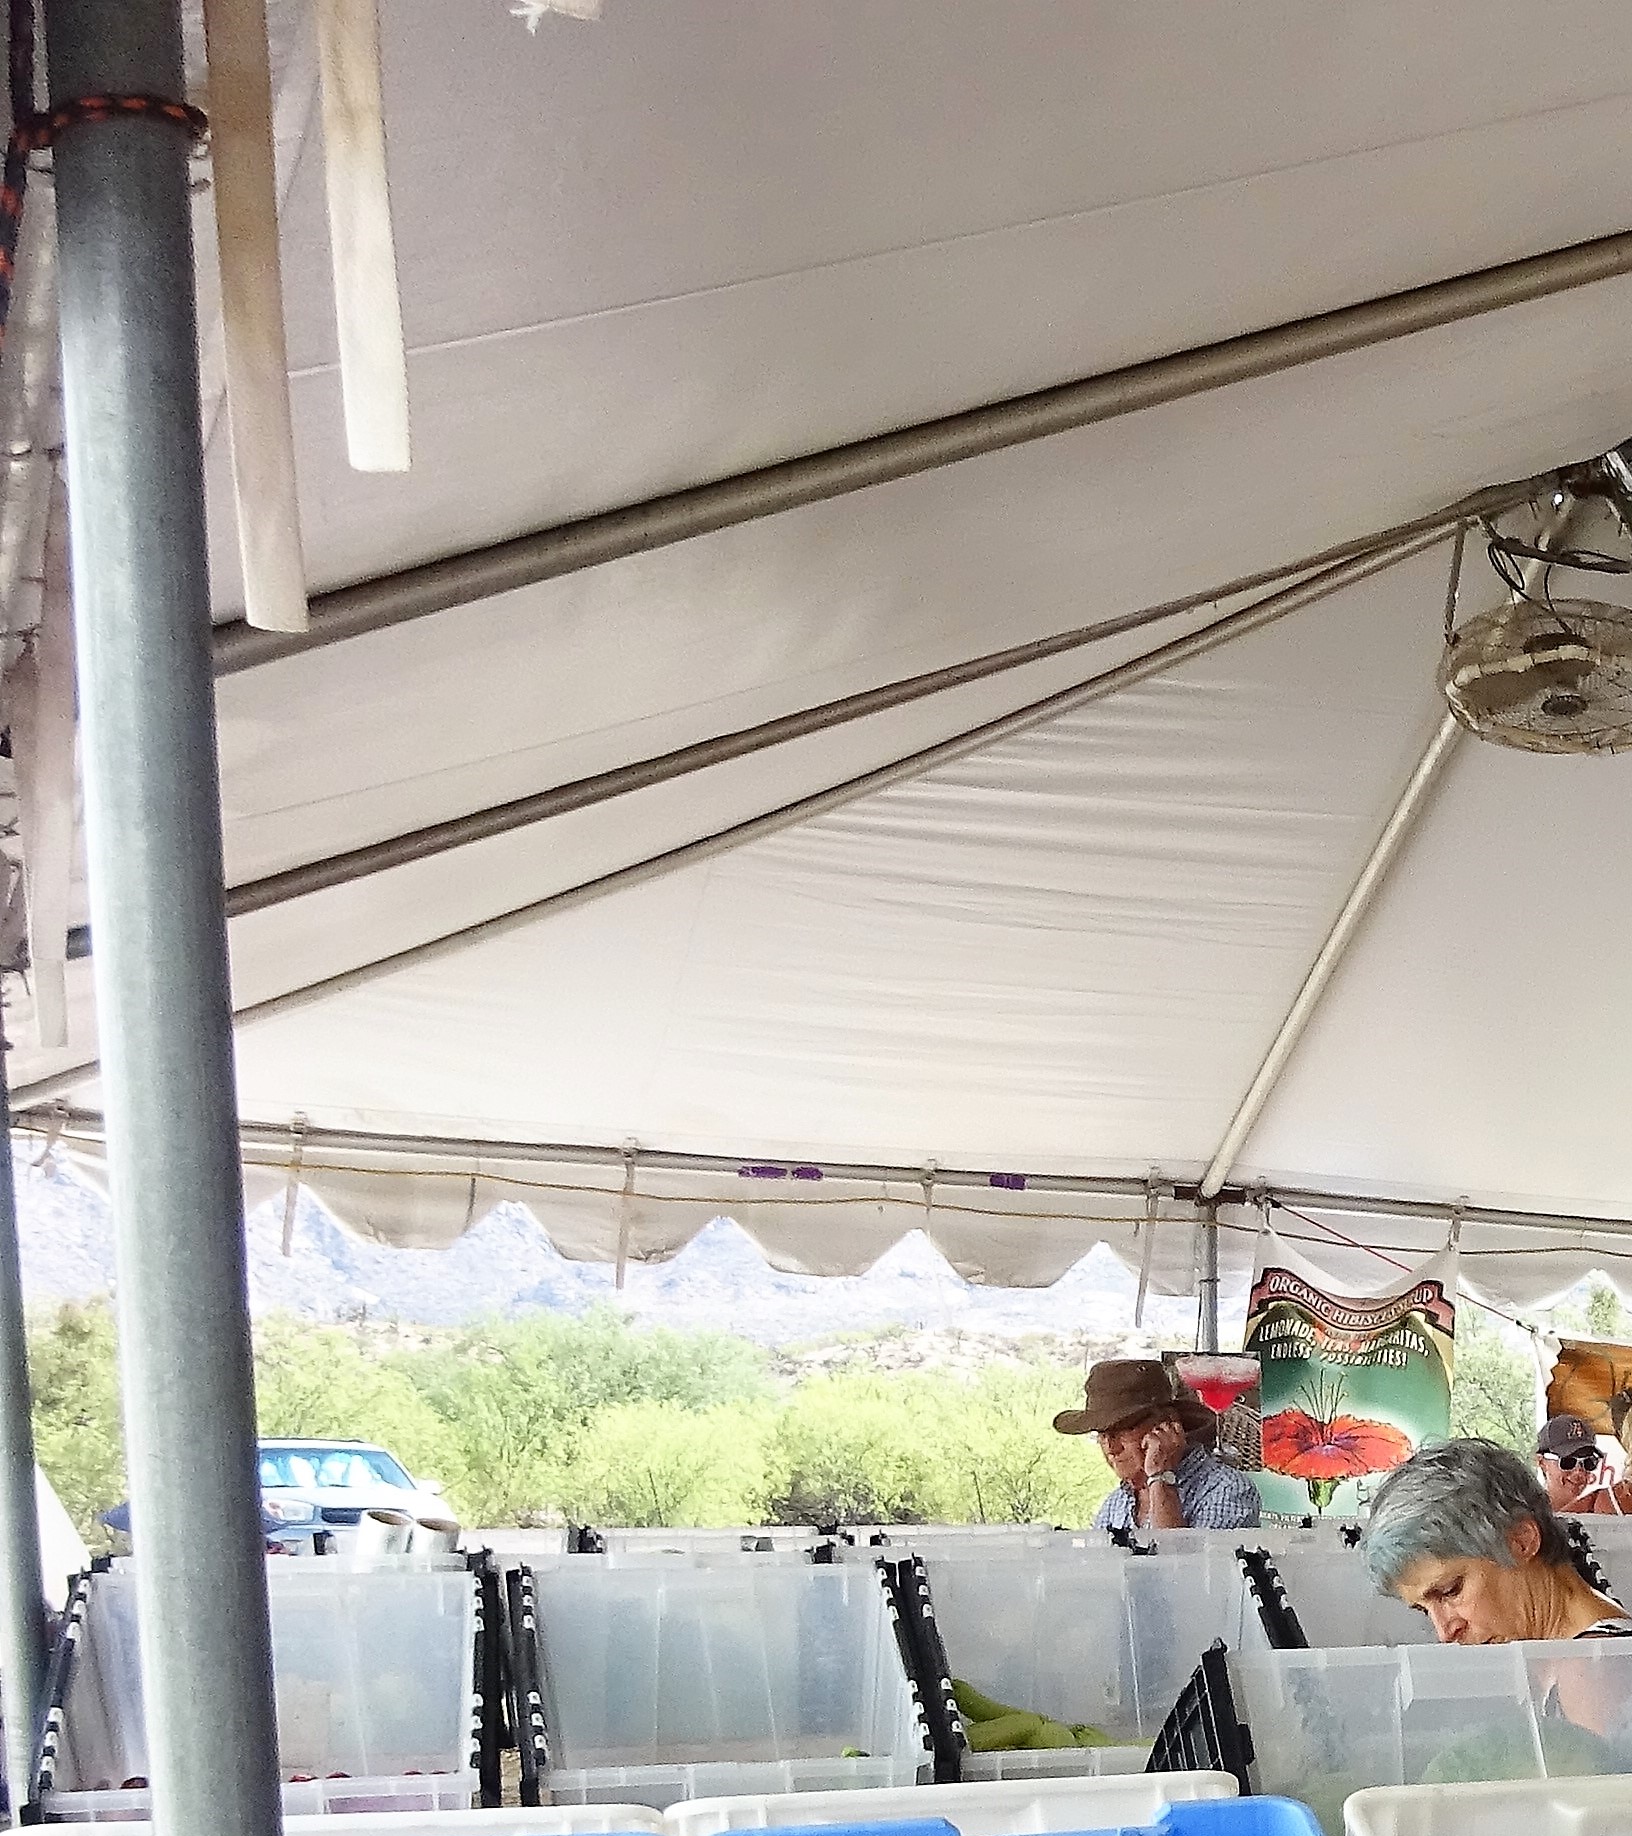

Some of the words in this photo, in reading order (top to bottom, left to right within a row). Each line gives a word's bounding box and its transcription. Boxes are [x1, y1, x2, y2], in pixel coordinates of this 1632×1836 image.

[1269, 1275, 1331, 1318] ORGANIC
[1332, 1306, 1396, 1326] HIBISC
[1258, 1318, 1316, 1346] LEMONADE,
[1270, 1341, 1313, 1359] ENDLESS
